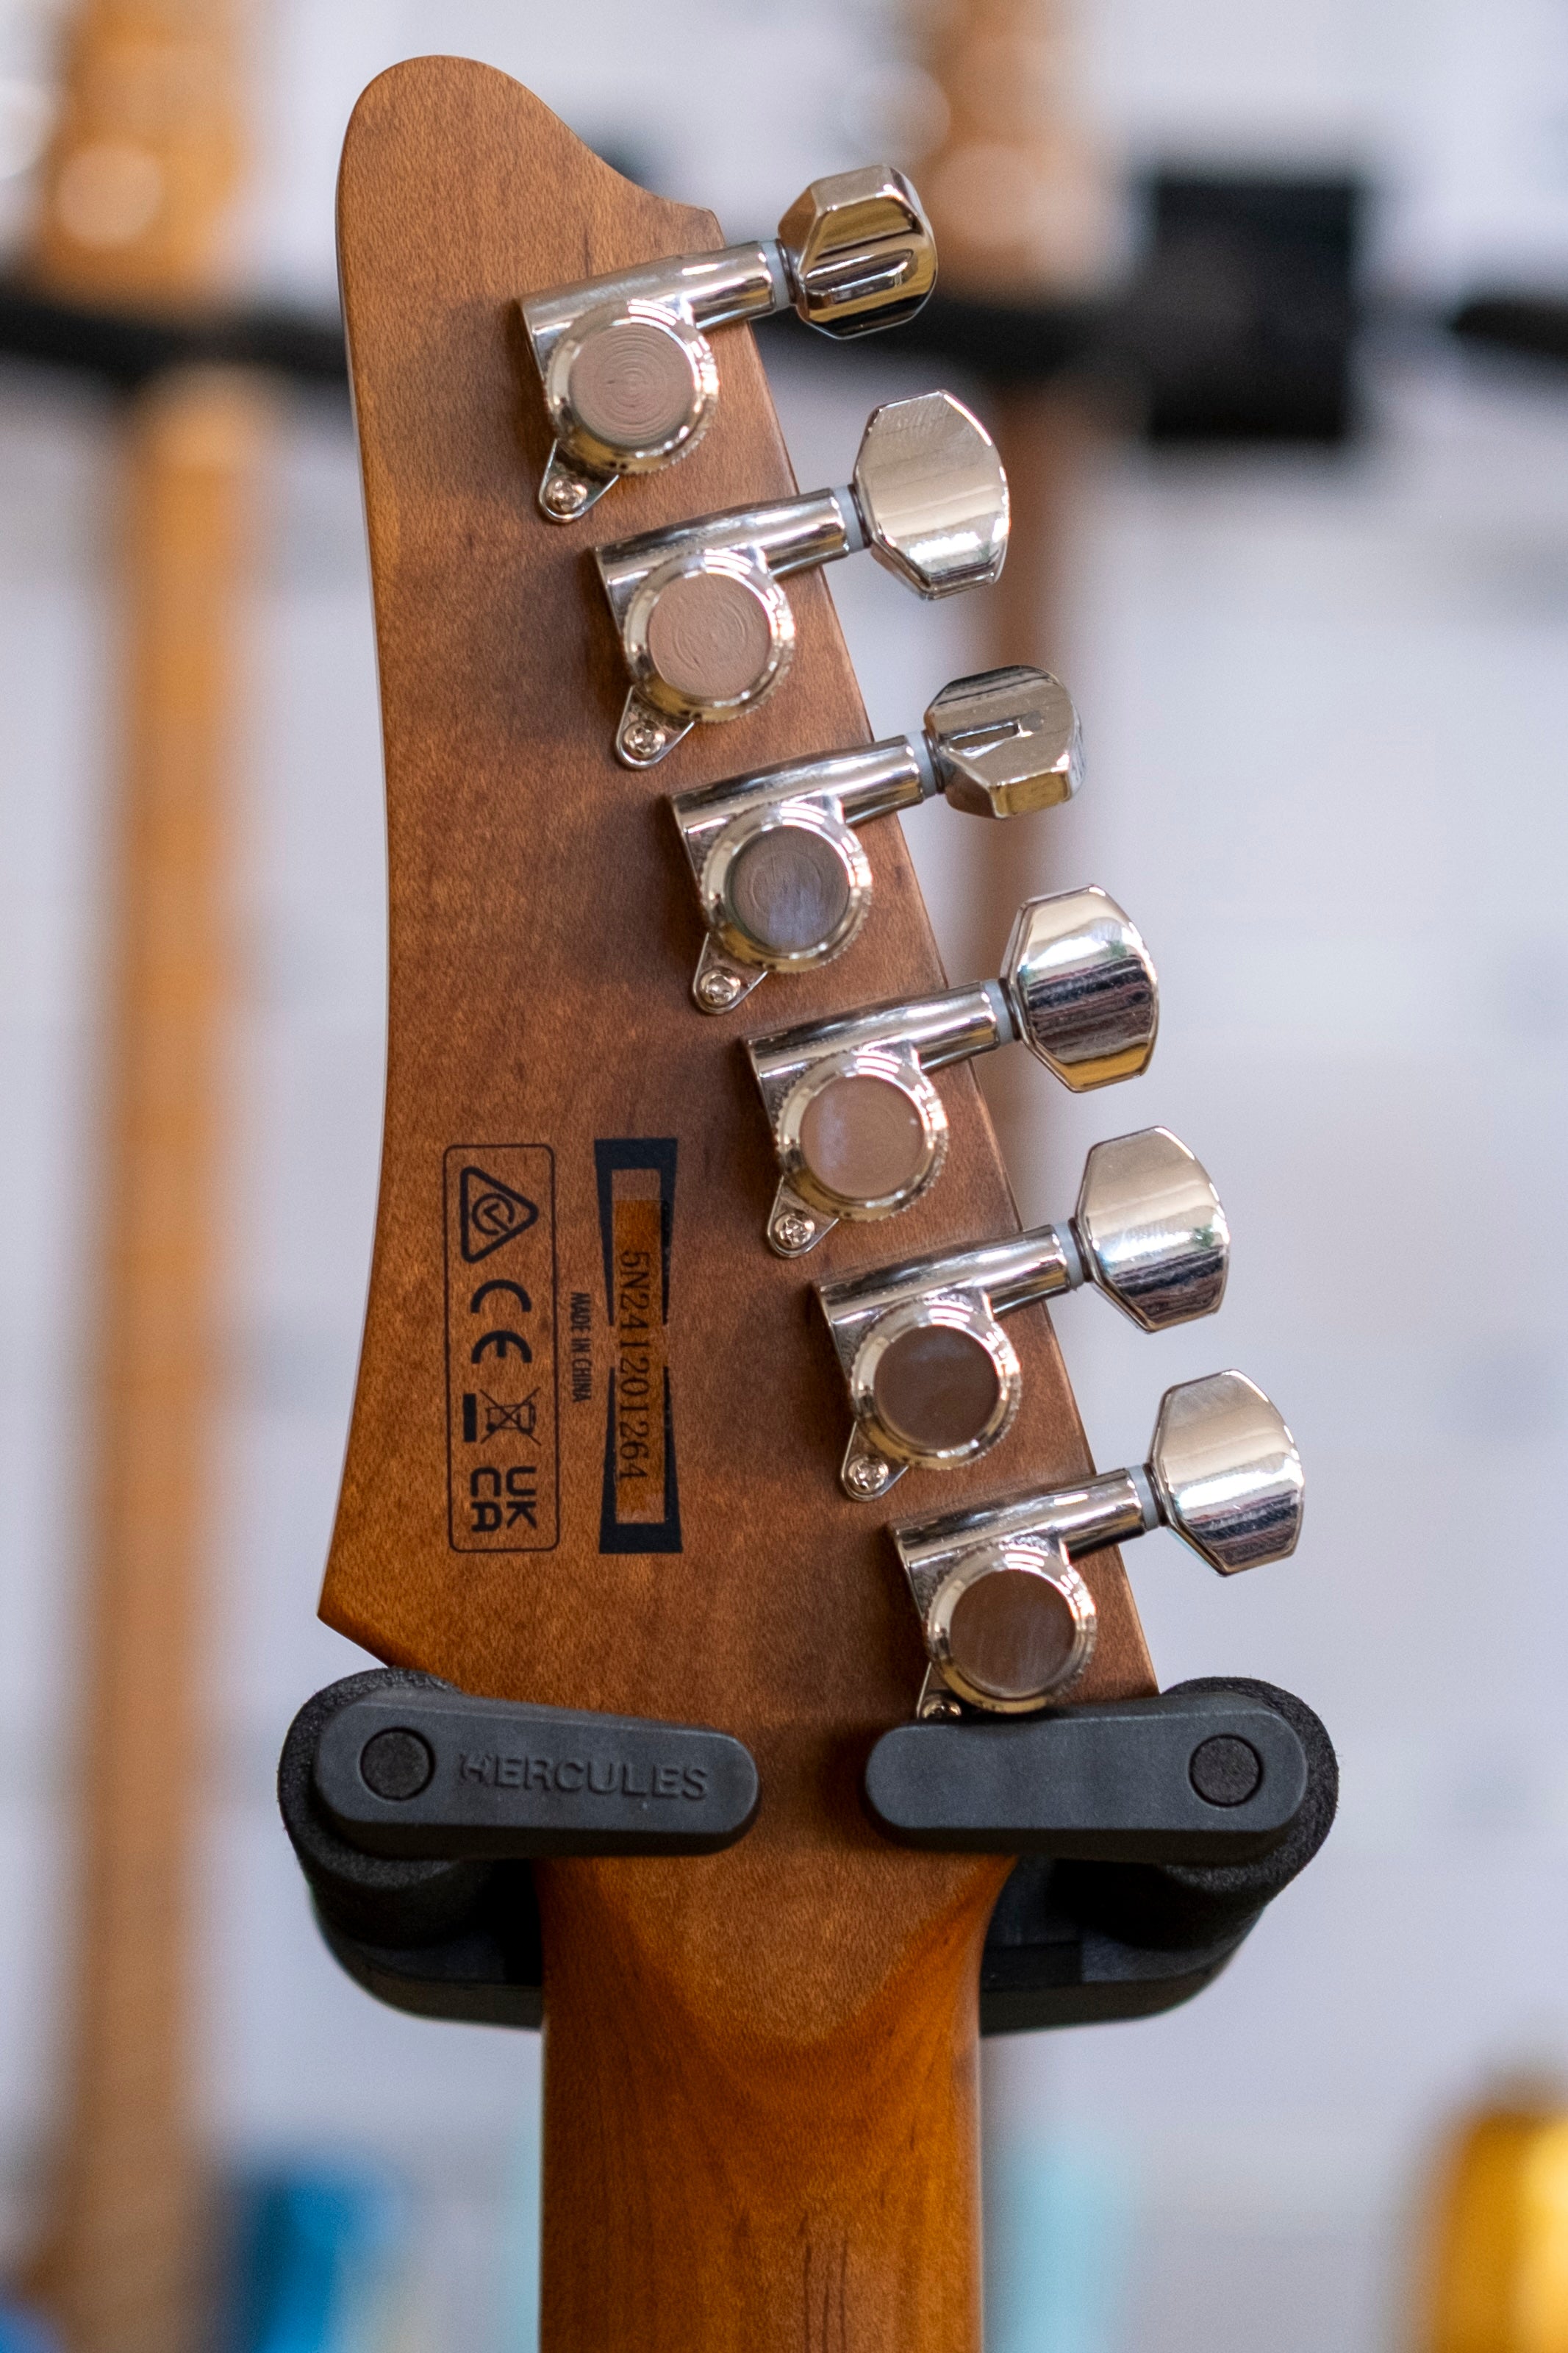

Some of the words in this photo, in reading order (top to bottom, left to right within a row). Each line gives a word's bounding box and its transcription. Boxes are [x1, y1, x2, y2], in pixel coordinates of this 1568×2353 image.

[470, 1279, 532, 1364] CE
[570, 1292, 591, 1332] MADE
[571, 1338, 591, 1354] IN
[617, 1250, 651, 1480] 5N241201264
[571, 1358, 593, 1403] CHINA
[470, 1467, 503, 1532] CA
[506, 1466, 537, 1529] UK
[459, 1754, 708, 1801] HERCULES
